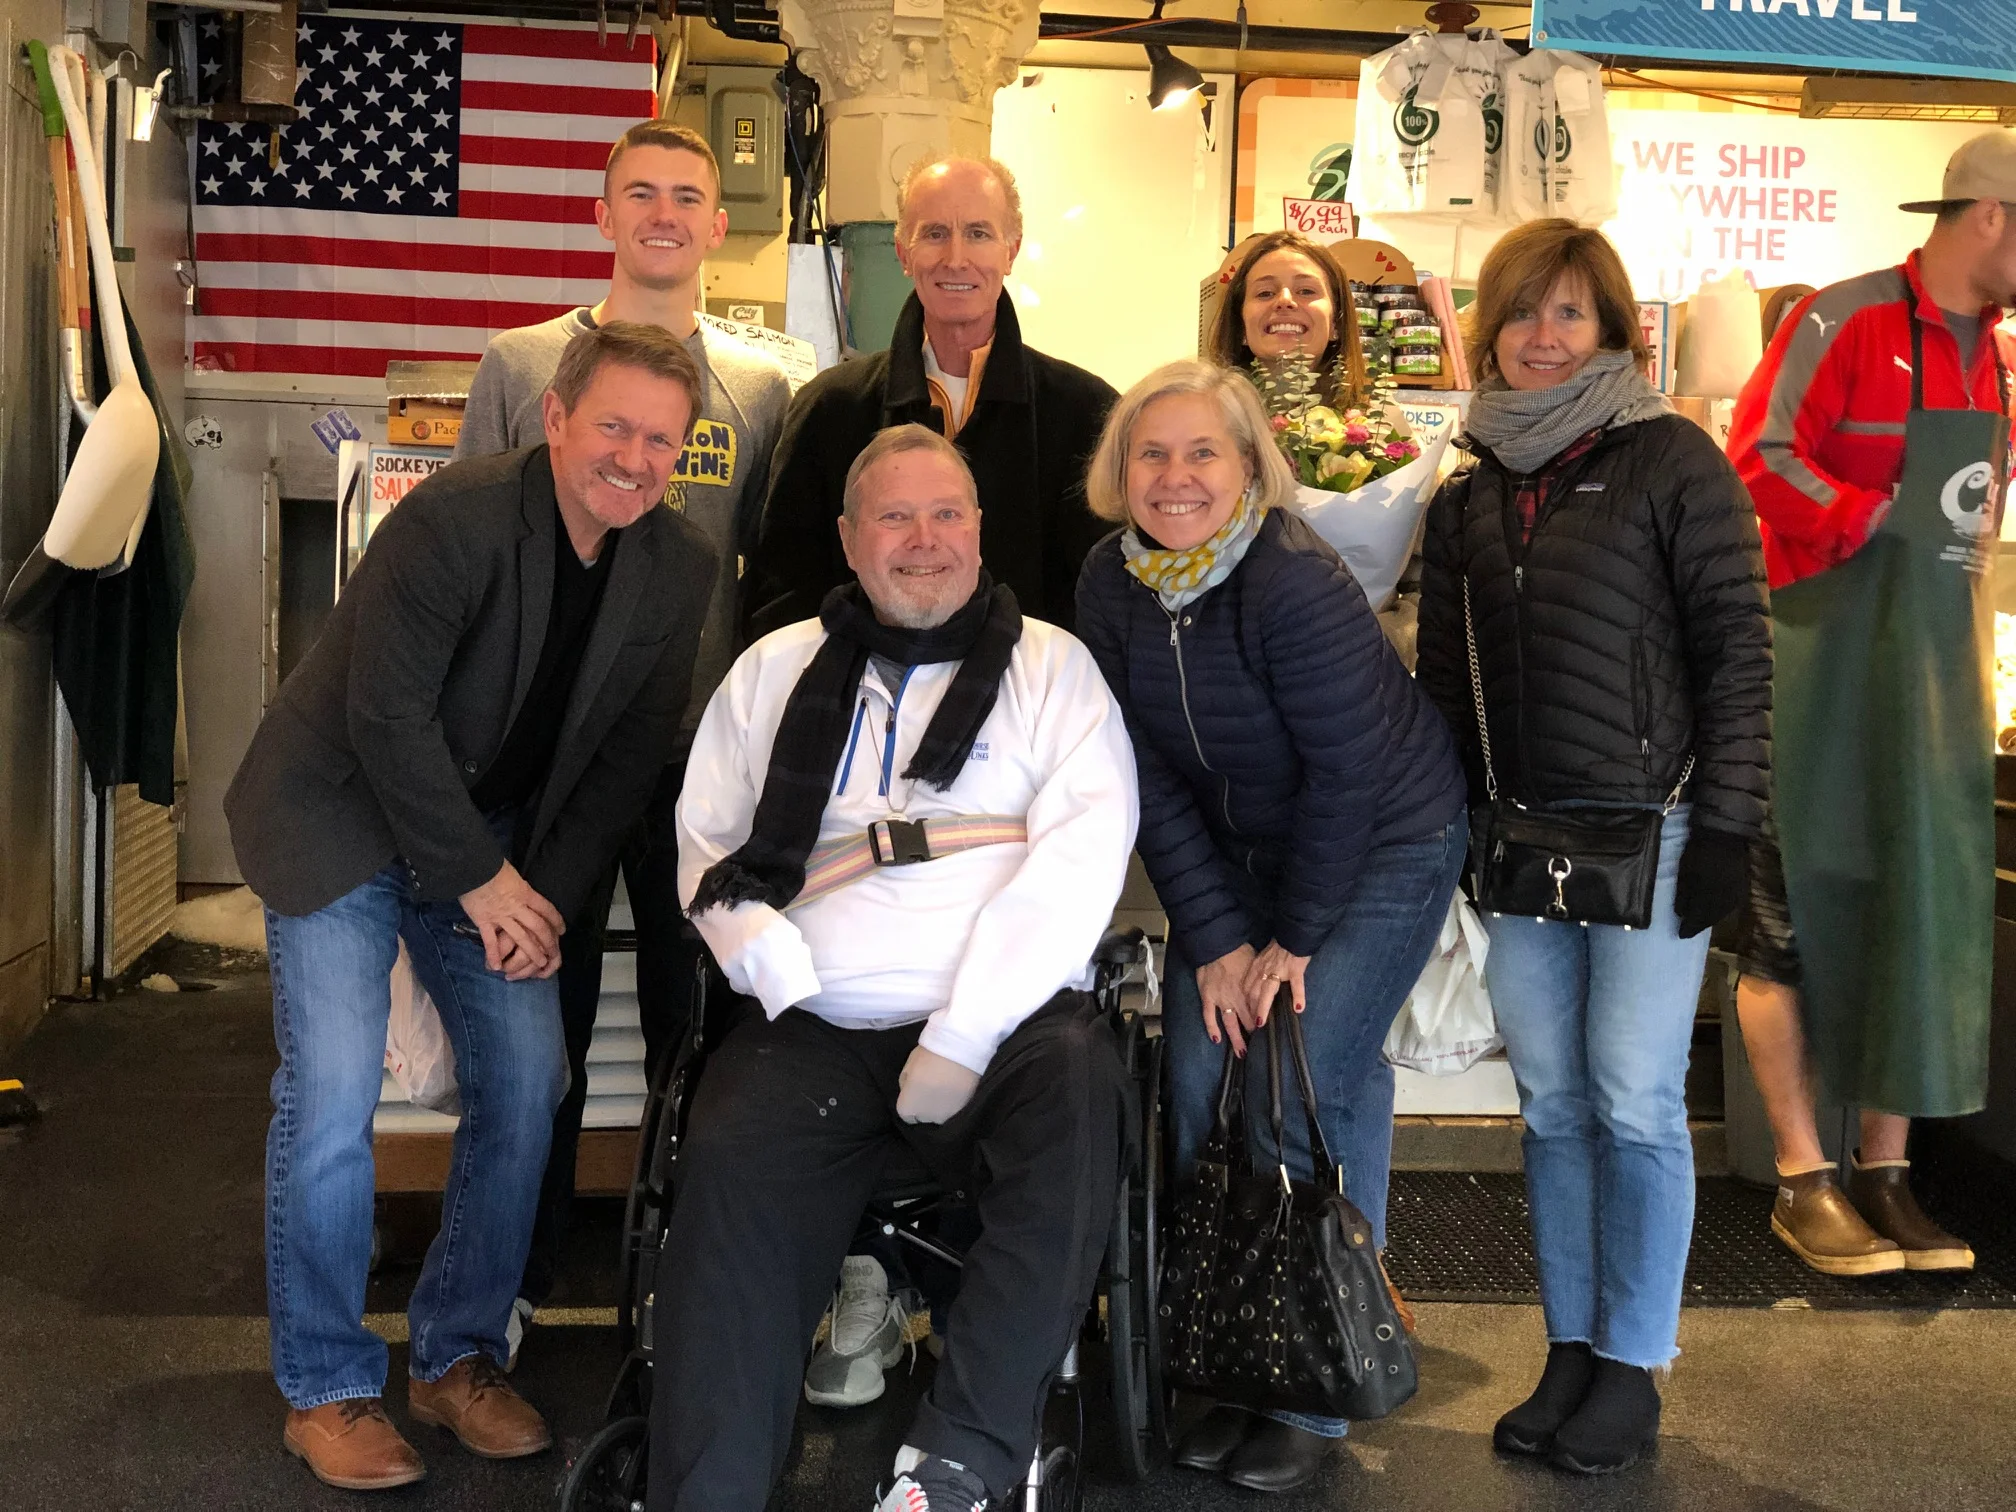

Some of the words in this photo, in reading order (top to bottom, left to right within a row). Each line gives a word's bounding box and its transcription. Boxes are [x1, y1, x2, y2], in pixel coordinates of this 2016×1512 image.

[1632, 141, 1694, 175] WE
[1718, 143, 1806, 179] SHIP
[1669, 184, 1837, 223] YWHERE
[1318, 224, 1348, 234] each
[1713, 227, 1786, 261] THE
[746, 326, 796, 348] SALMON
[1405, 410, 1445, 427] OKED
